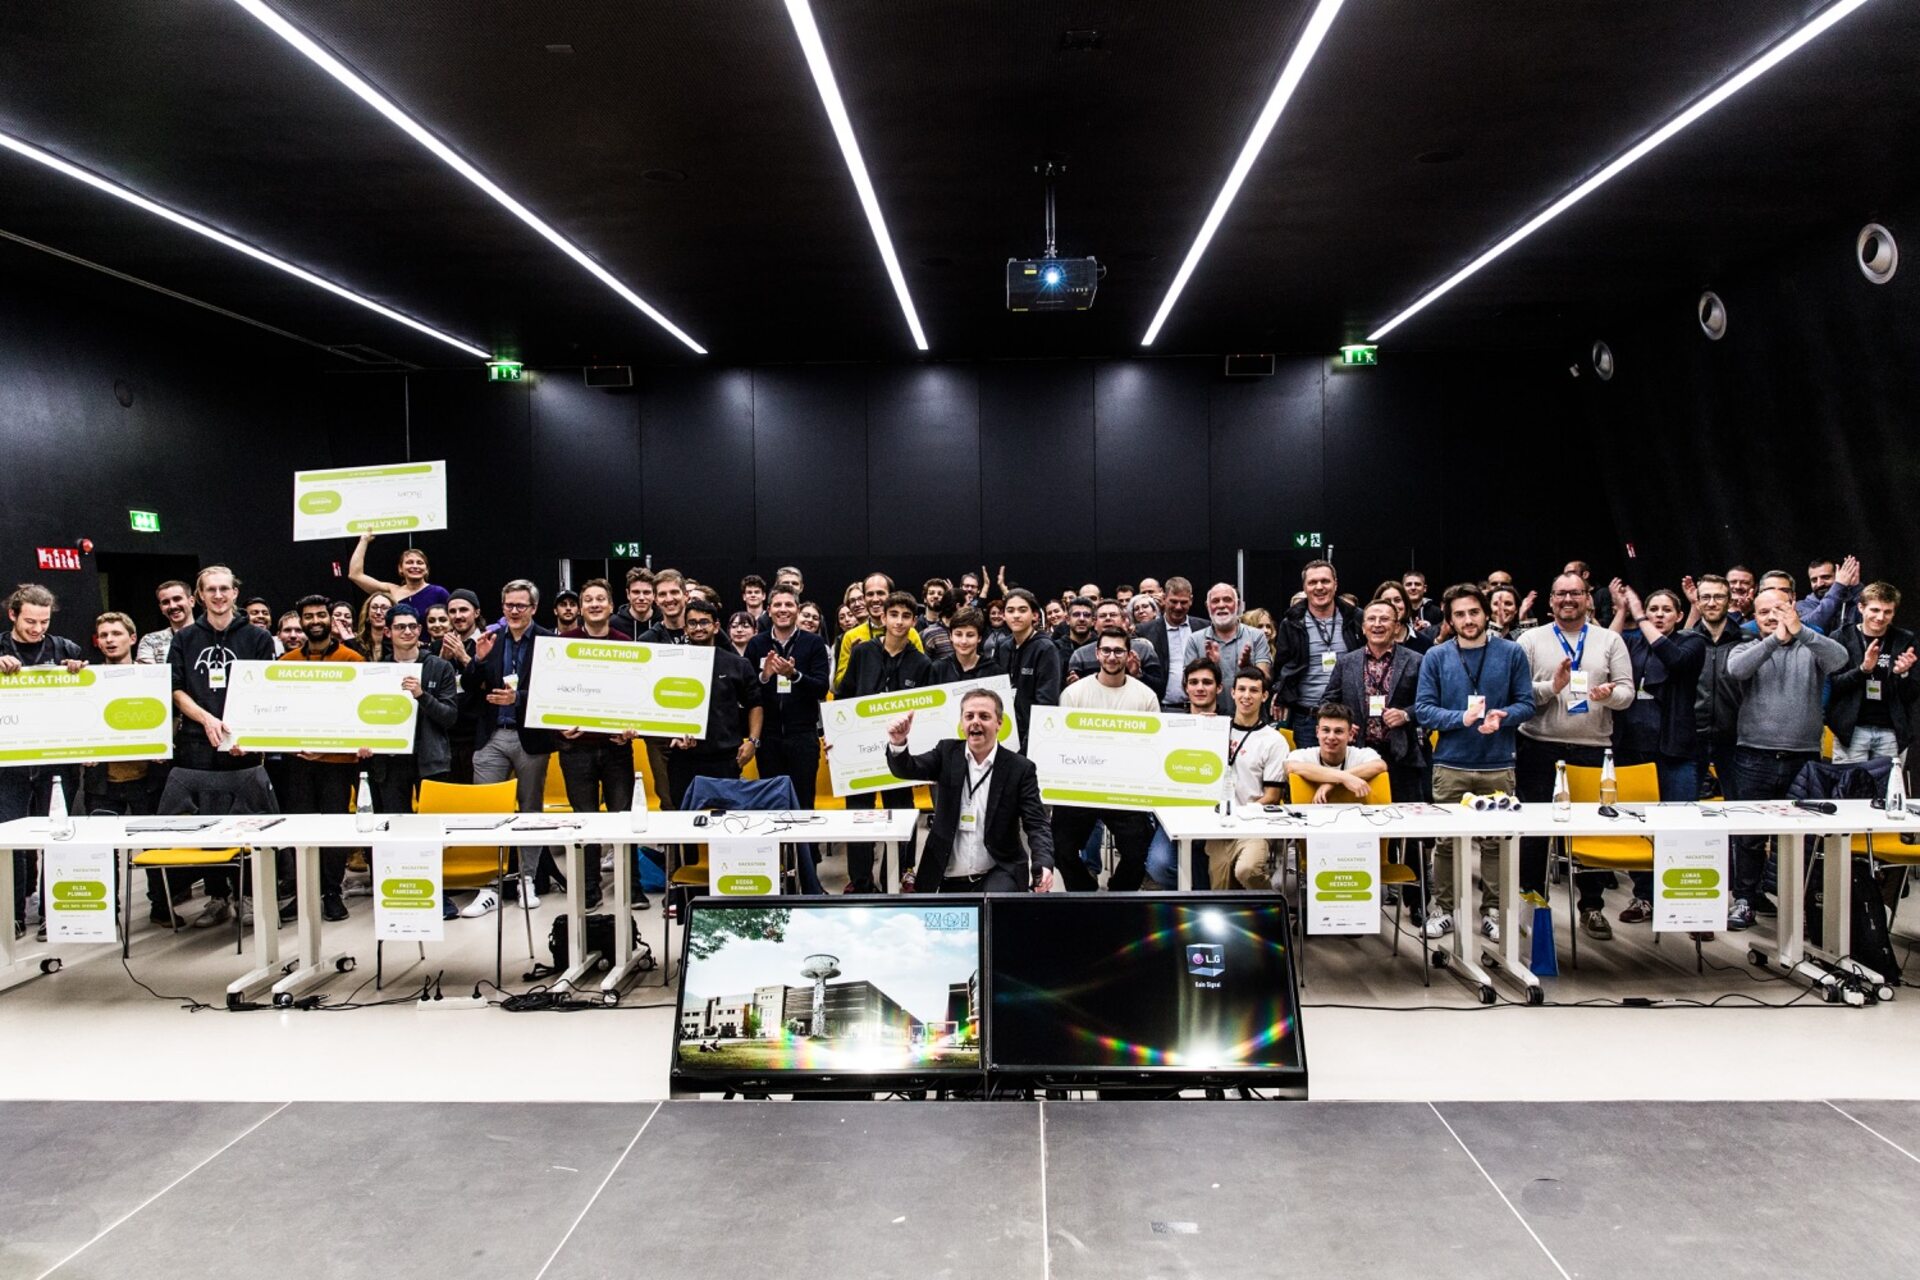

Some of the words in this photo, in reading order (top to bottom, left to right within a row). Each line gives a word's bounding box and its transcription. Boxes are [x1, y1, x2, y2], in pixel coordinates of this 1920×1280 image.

[357, 518, 409, 530] HACKATHON
[578, 647, 639, 660] HACKATHON
[1, 674, 80, 685] HACKATHON
[278, 669, 343, 679] HACKATHON
[868, 695, 933, 713] HACKATHON
[1078, 717, 1148, 730] HACKATHON
[1205, 954, 1221, 964] LG
